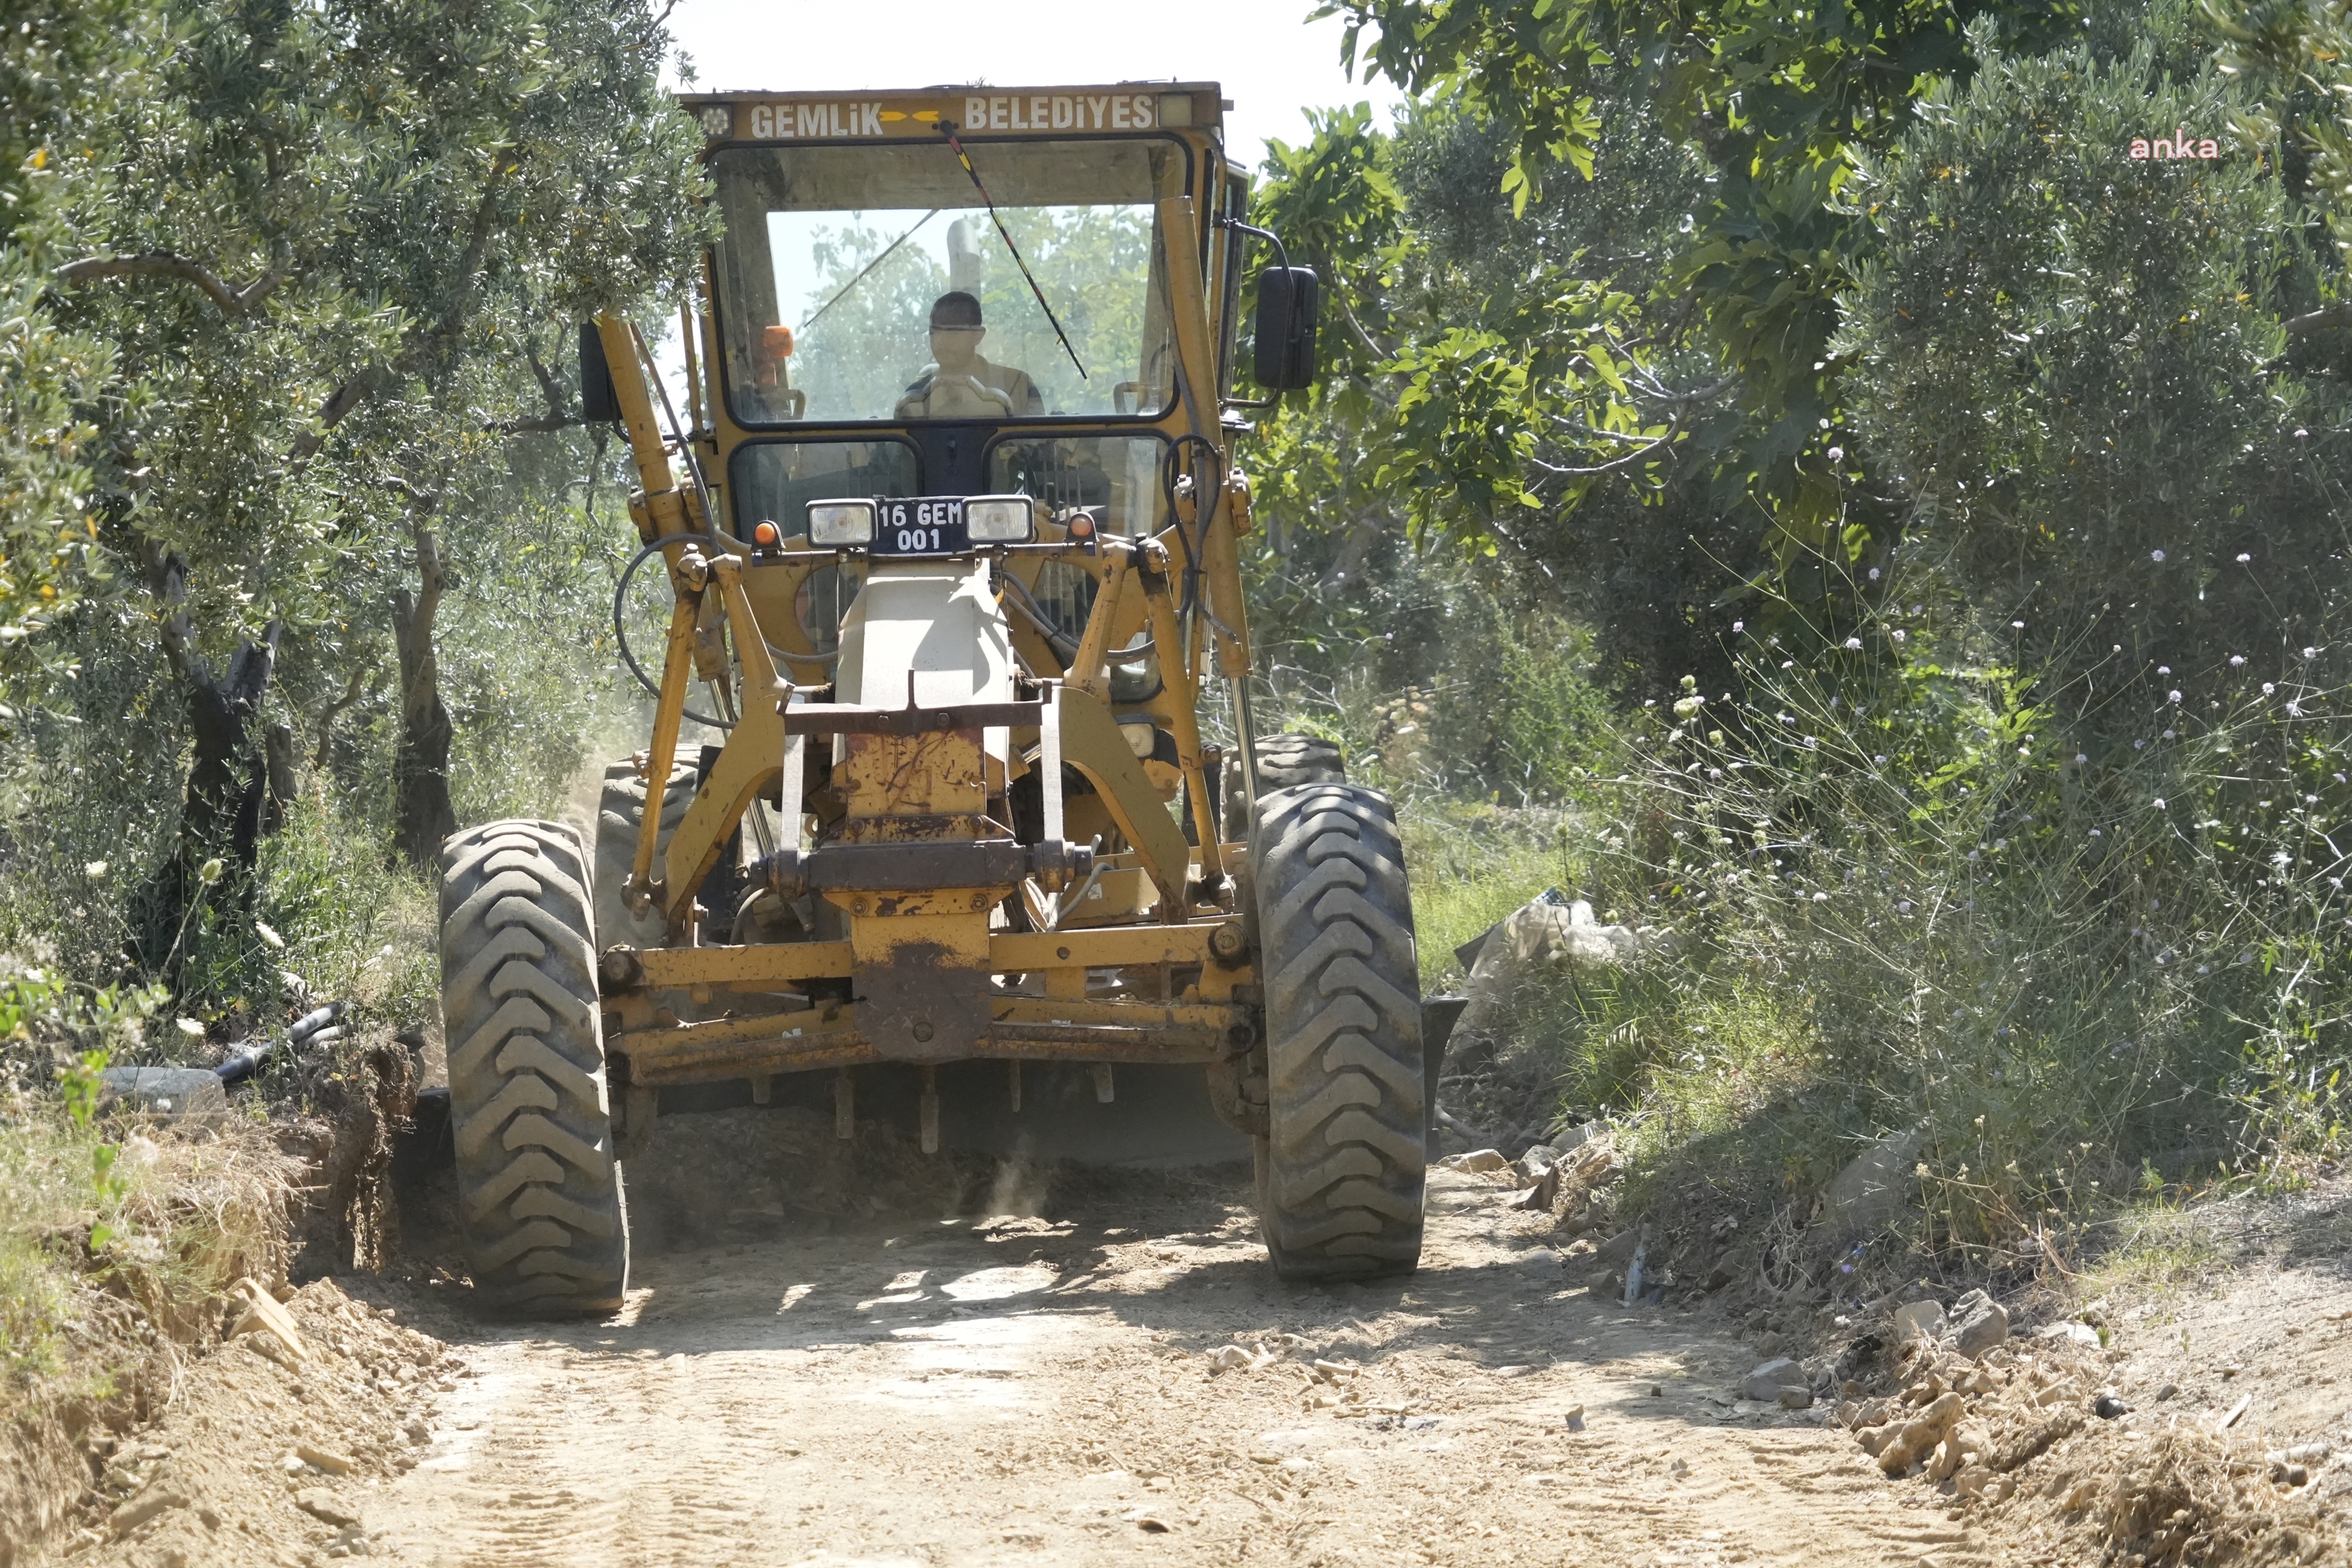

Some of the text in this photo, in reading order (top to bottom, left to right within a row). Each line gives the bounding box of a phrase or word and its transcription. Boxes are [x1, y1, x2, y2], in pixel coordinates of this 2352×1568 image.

[880, 503, 963, 527] 16 GEM
[898, 528, 940, 550] 001
